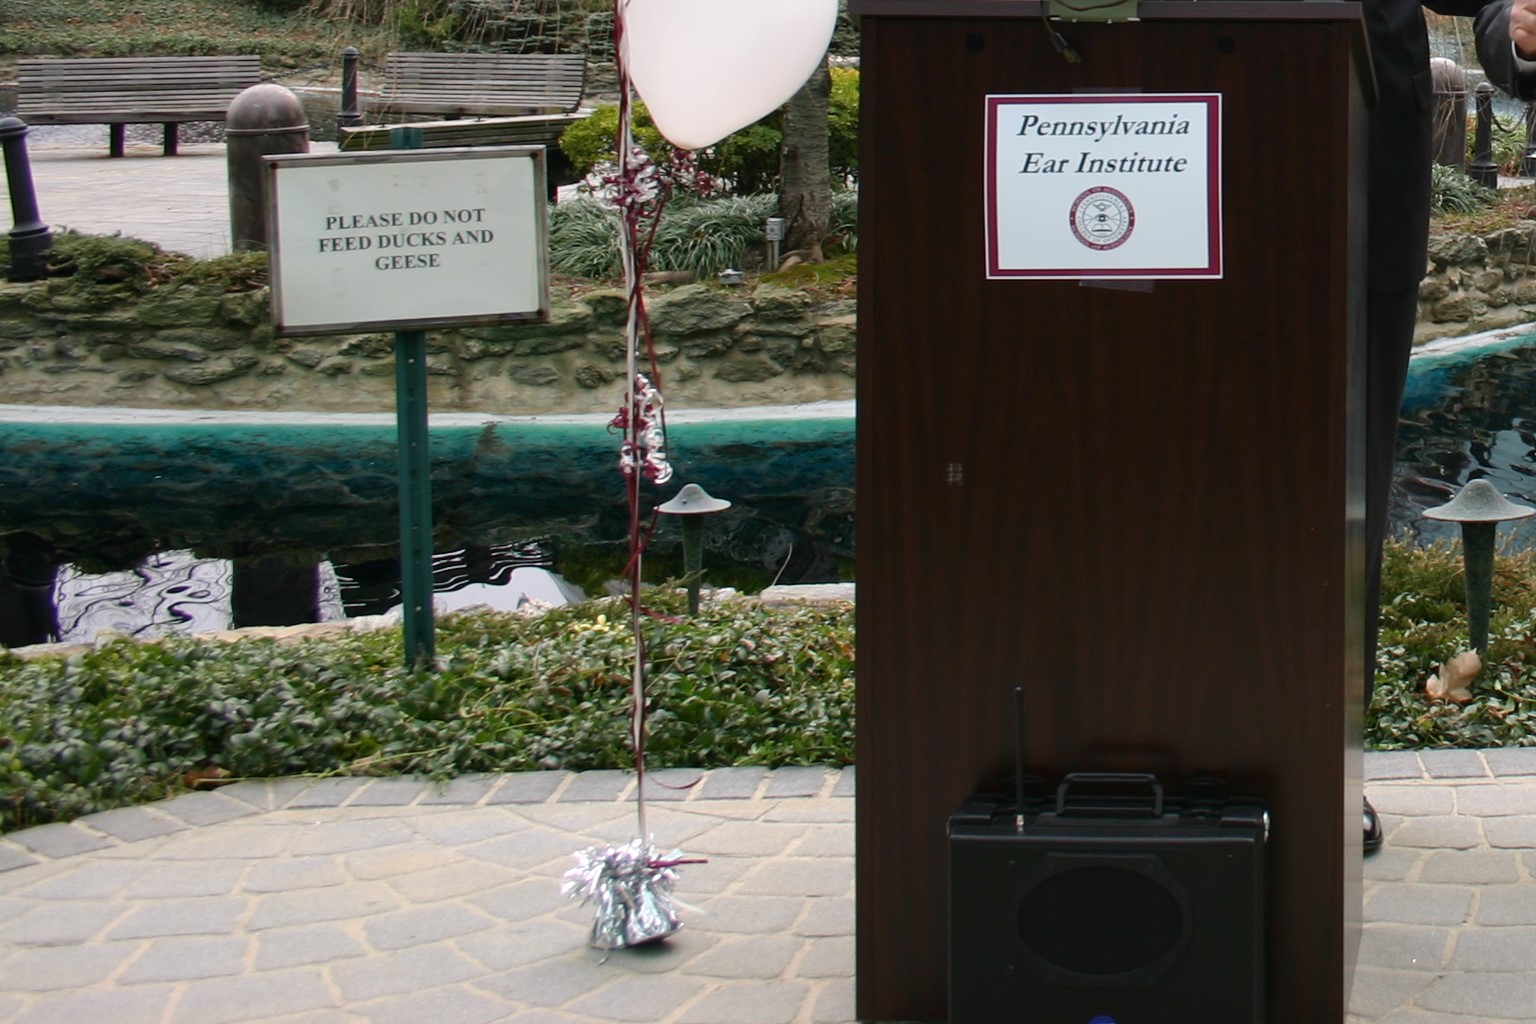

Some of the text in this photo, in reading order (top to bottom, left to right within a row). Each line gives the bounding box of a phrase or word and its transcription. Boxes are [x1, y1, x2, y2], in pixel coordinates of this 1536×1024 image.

[1016, 113, 1190, 142] Pennsylvania
[1019, 151, 1188, 174] Ear Institute
[325, 208, 486, 230] PLEASE DO NOT
[318, 229, 494, 253] FEED DUCKS AND
[375, 253, 441, 271] GEESE
